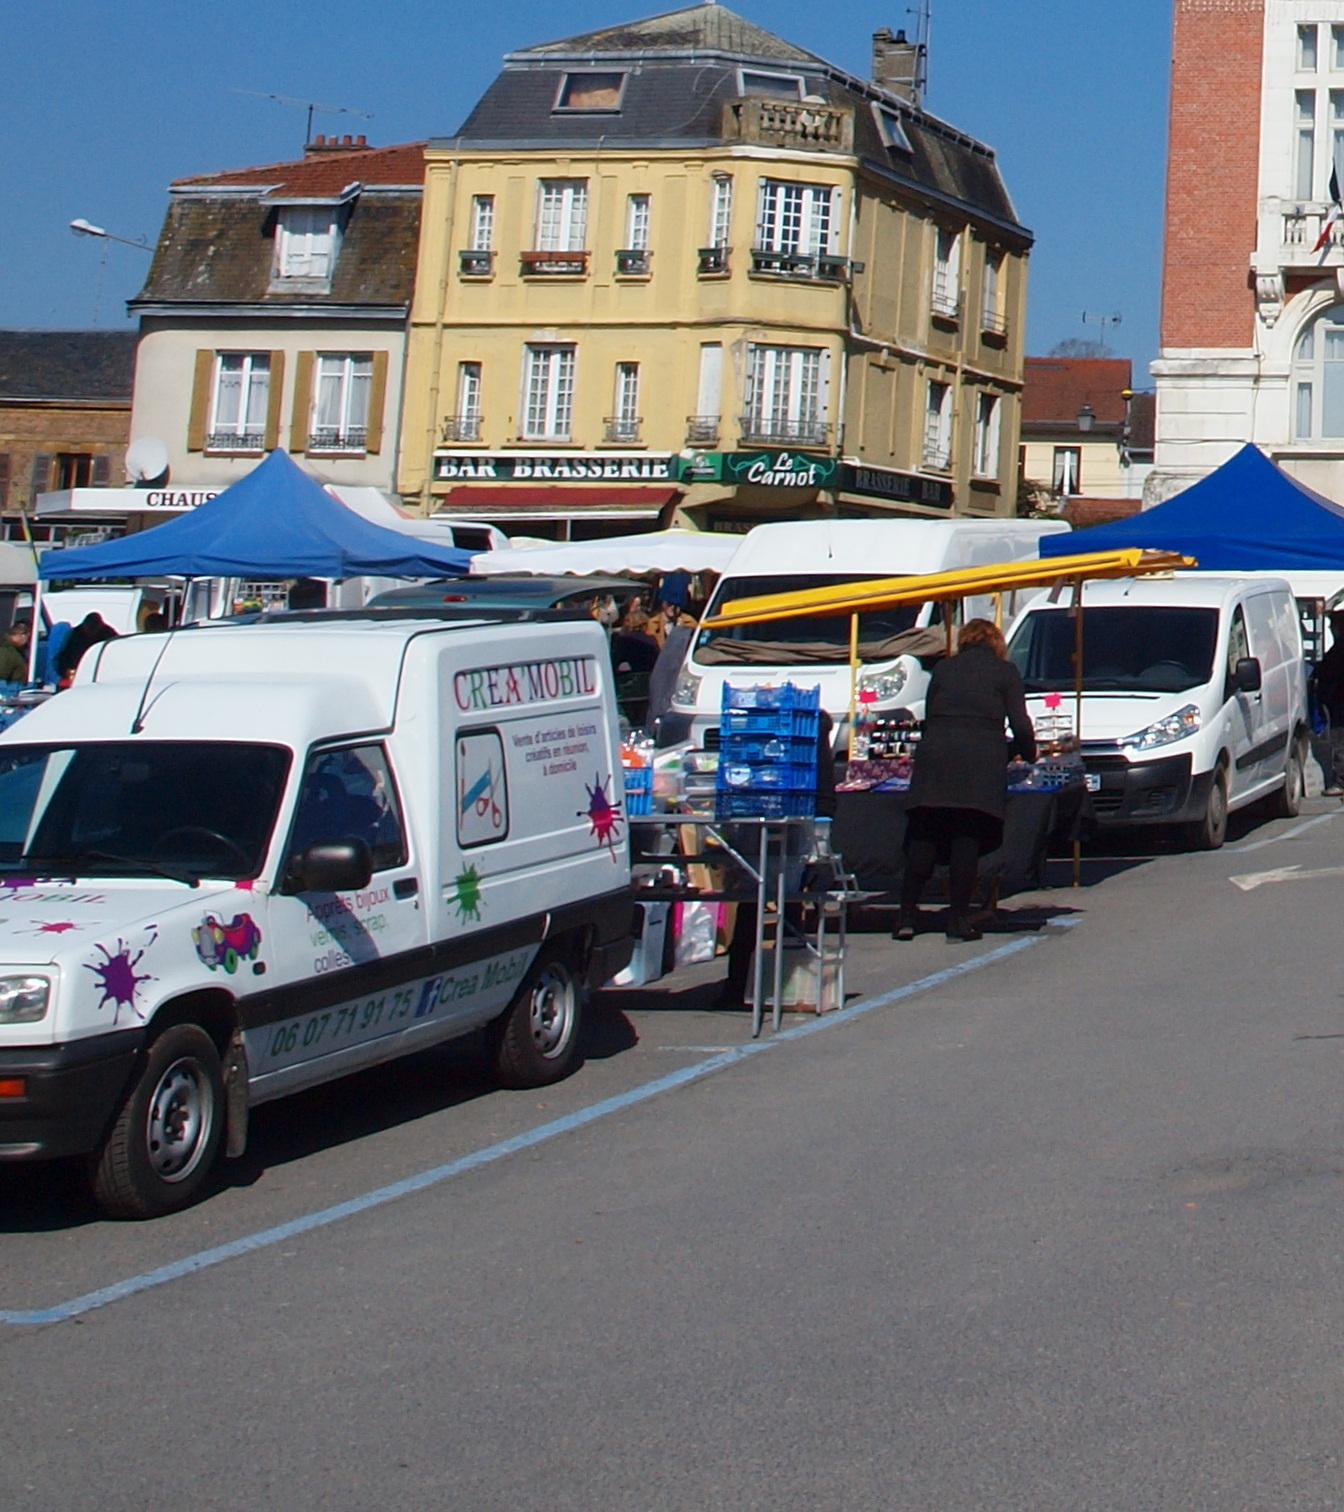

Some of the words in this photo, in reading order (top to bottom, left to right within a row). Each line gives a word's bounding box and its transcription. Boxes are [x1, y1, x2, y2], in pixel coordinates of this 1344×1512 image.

[438, 457, 497, 478] BAR
[512, 457, 670, 478] BRASSERIE
[747, 461, 817, 487] Carnot
[772, 452, 793, 472] Le
[855, 469, 911, 497] BRASSERIE
[921, 481, 942, 502] BAR
[355, 887, 391, 912] bijoux
[270, 1021, 300, 1057] 06
[302, 1014, 331, 1047] 07
[333, 1004, 359, 1037] 71
[361, 997, 385, 1029] 91
[388, 988, 414, 1021] 75
[440, 976, 477, 1005] Crea
